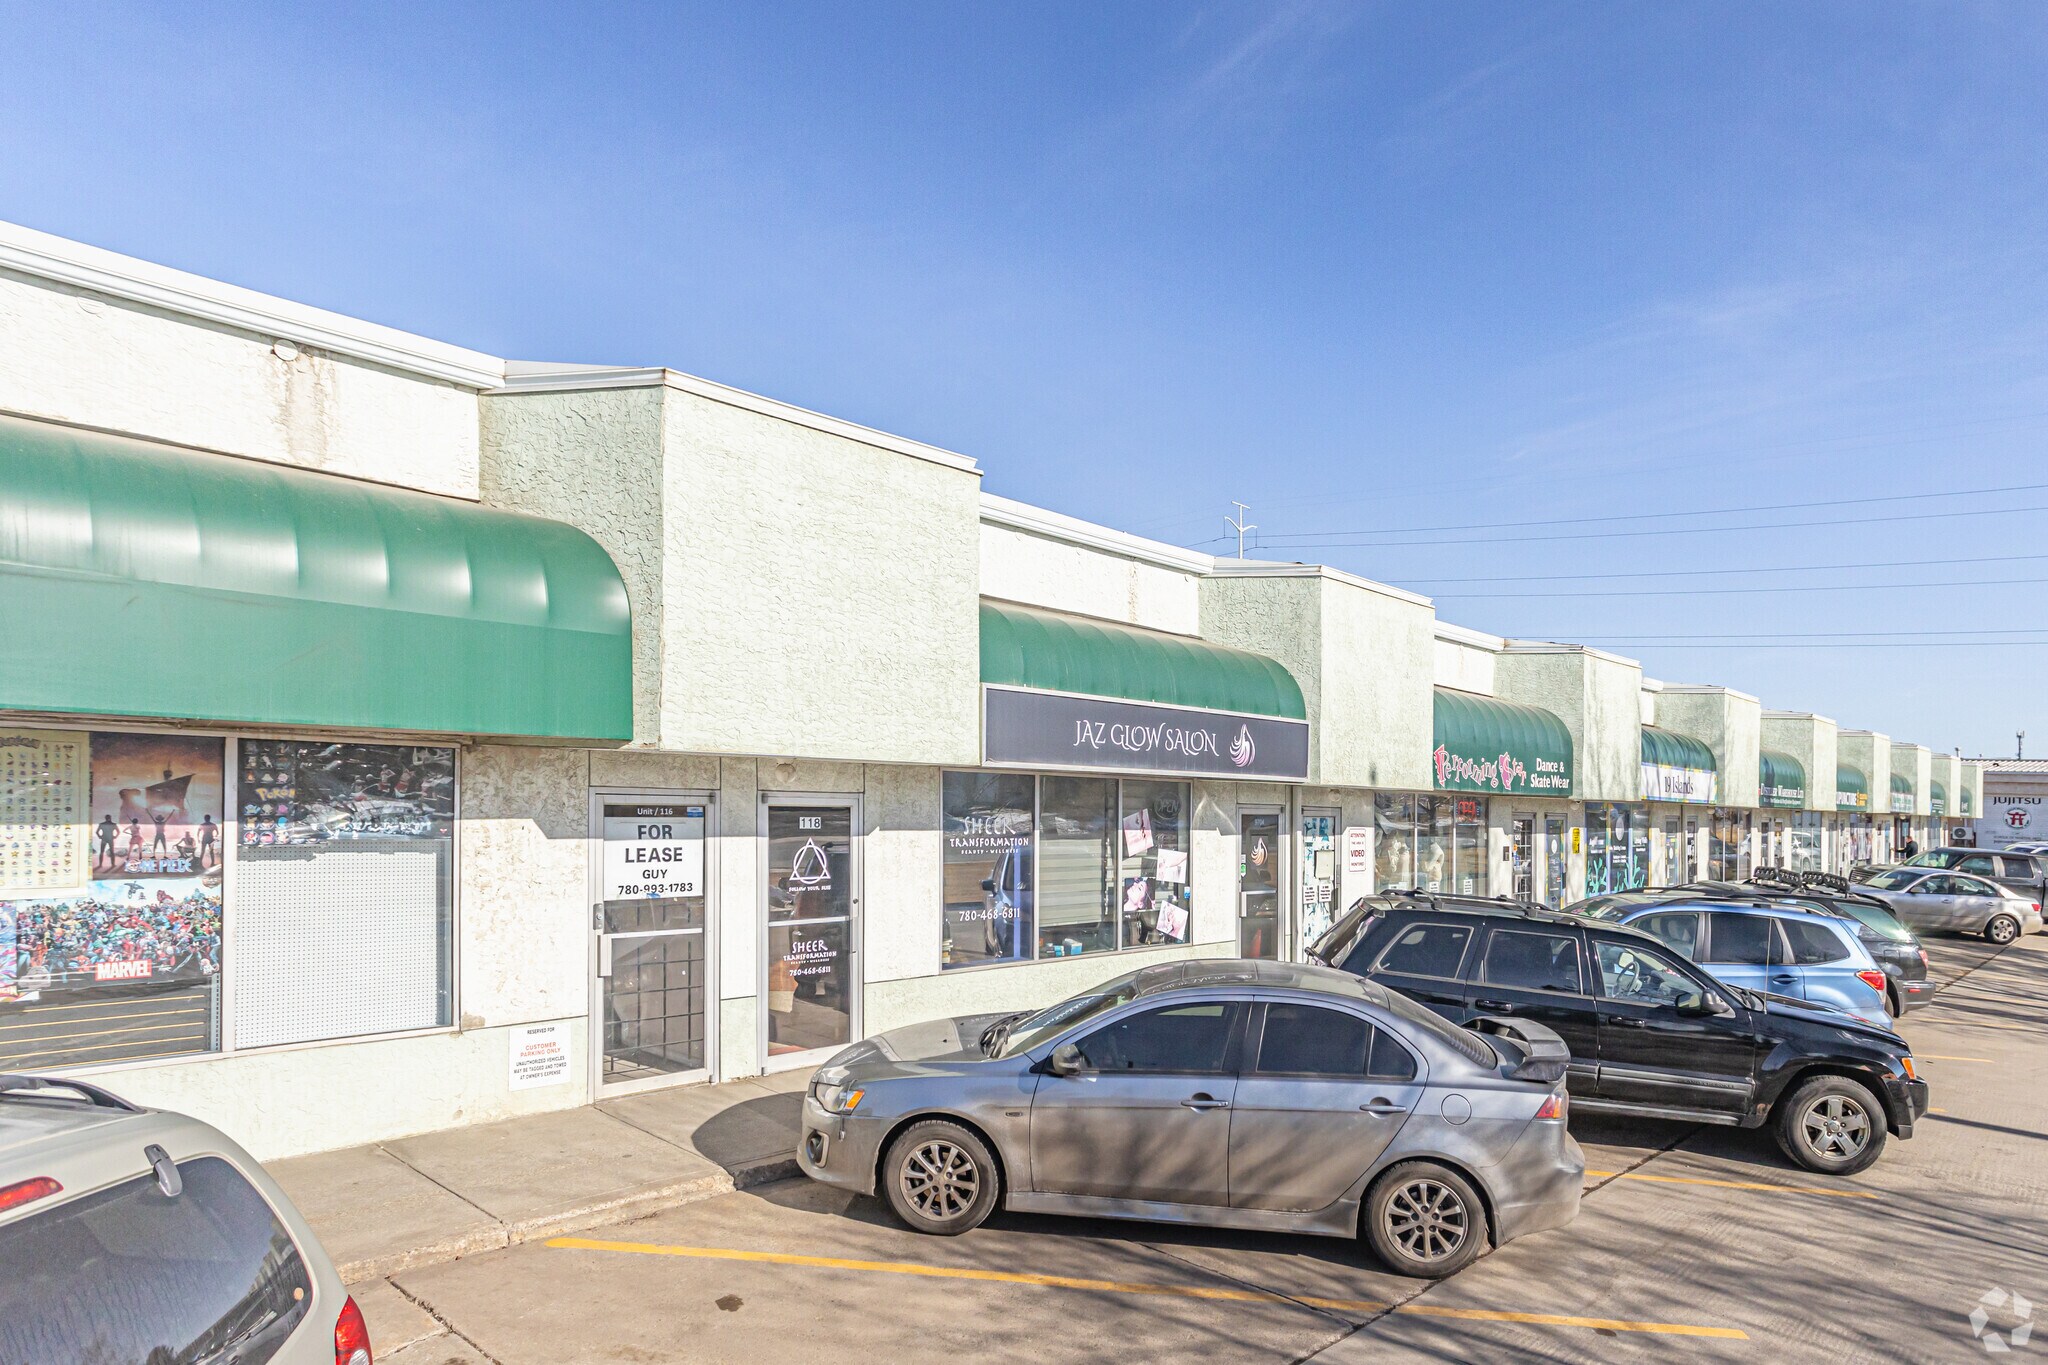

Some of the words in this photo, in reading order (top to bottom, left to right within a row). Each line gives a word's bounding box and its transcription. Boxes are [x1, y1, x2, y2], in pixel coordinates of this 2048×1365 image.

[1073, 719, 1106, 749] JAZ
[1110, 722, 1167, 751] GLOW
[1165, 728, 1219, 757] SALON
[1536, 758, 1558, 773] Dance
[1559, 761, 1565, 773] &
[1530, 773, 1551, 788] Skate
[1551, 775, 1570, 789] Wear
[1672, 775, 1694, 795] Islands
[1993, 796, 2042, 806] JUJITSU
[637, 807, 653, 815] Unit
[660, 807, 673, 815] 116
[801, 817, 820, 828] 118
[963, 816, 1016, 835] SHEER
[637, 824, 673, 840] FOR
[950, 837, 1029, 847] TRANSFORMATION
[625, 847, 683, 863] LEASE
[1350, 849, 1365, 858] VIDEO
[159, 857, 194, 873] PIECE
[642, 869, 668, 879] GUY
[618, 882, 693, 896] 780-993-1783
[959, 907, 1021, 922] 780-468-6811
[792, 939, 828, 954] SHEER
[783, 951, 837, 961] TRANSFORMATION
[97, 960, 150, 979] MARVEL
[525, 1041, 557, 1050] CUSTOMER
[516, 1058, 546, 1067] UNAUTHORIZED
